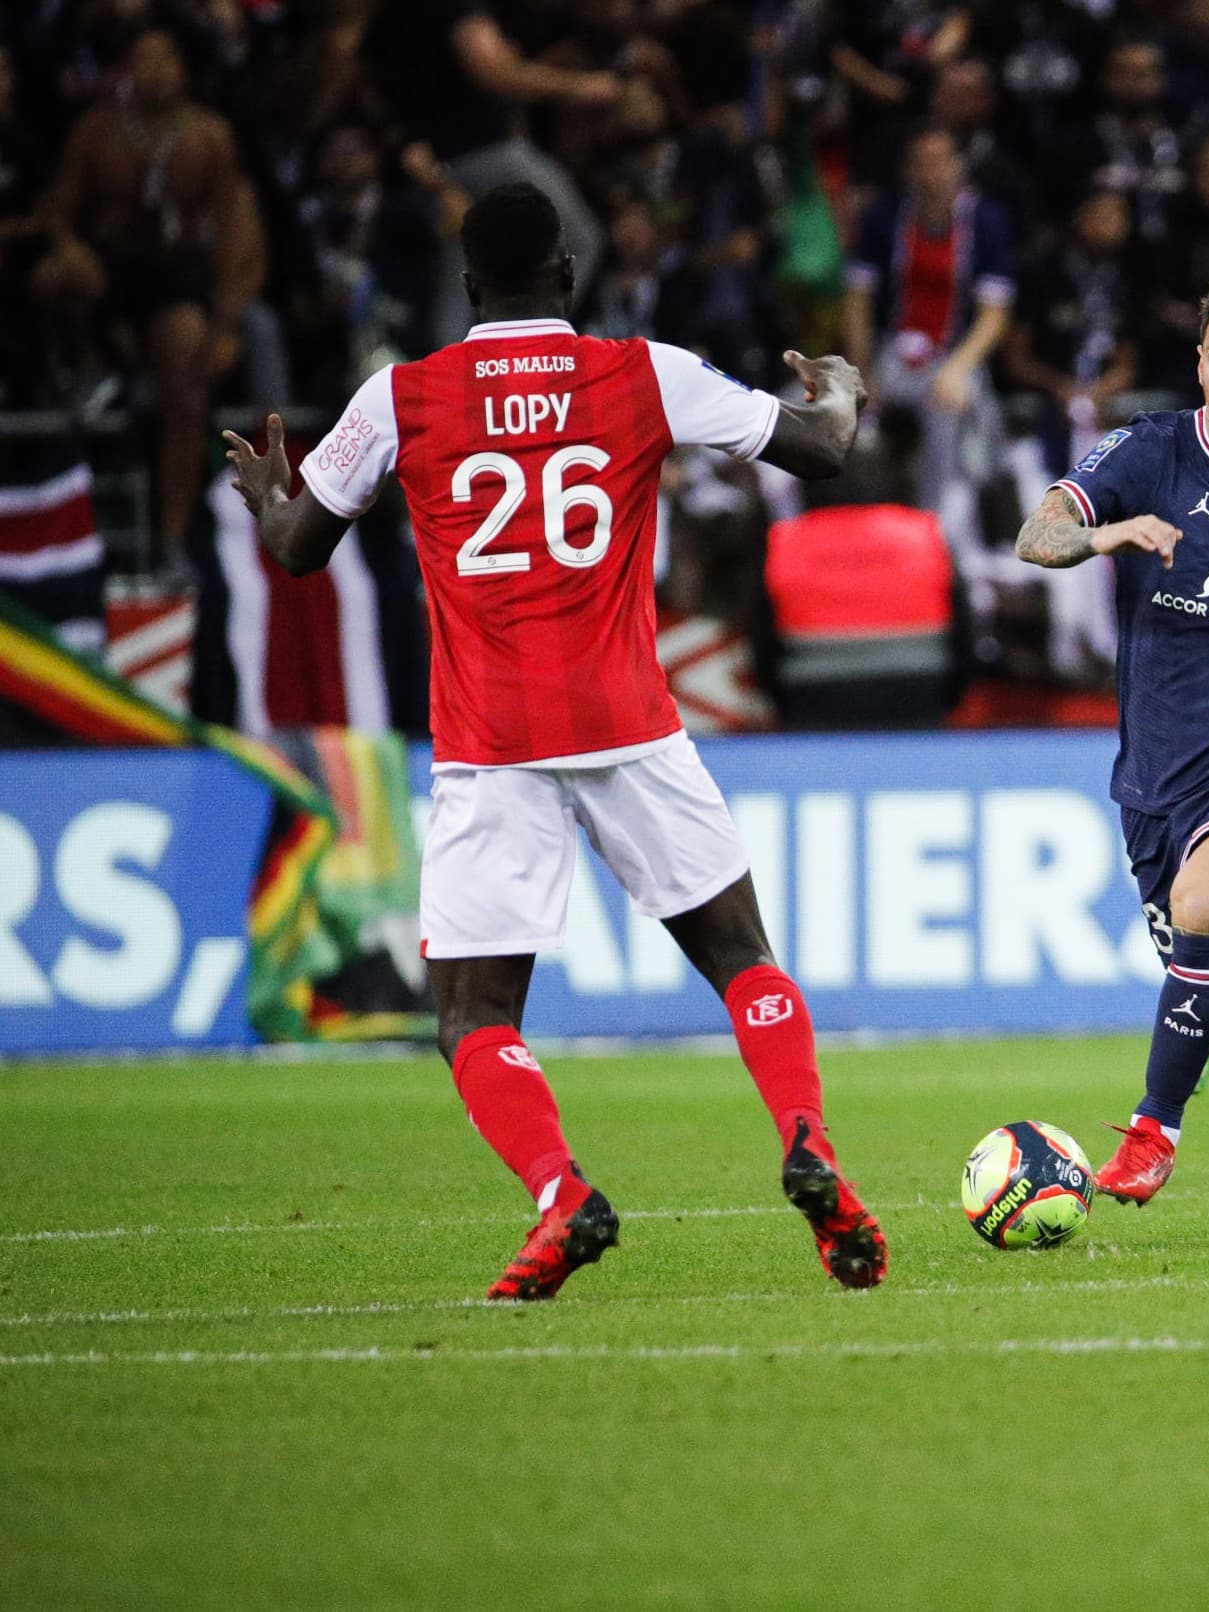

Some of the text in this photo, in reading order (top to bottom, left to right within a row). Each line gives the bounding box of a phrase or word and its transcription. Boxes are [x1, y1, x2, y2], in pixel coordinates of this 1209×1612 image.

[475, 355, 576, 379] SOS MALUS
[484, 392, 572, 436] LOPY
[319, 407, 361, 472] GRAND
[334, 418, 373, 474] REIMS
[451, 444, 614, 577] 26
[1151, 591, 1208, 617] ACCOR
[1164, 1015, 1205, 1038] PARIS
[980, 1177, 1032, 1237] uhlsport
